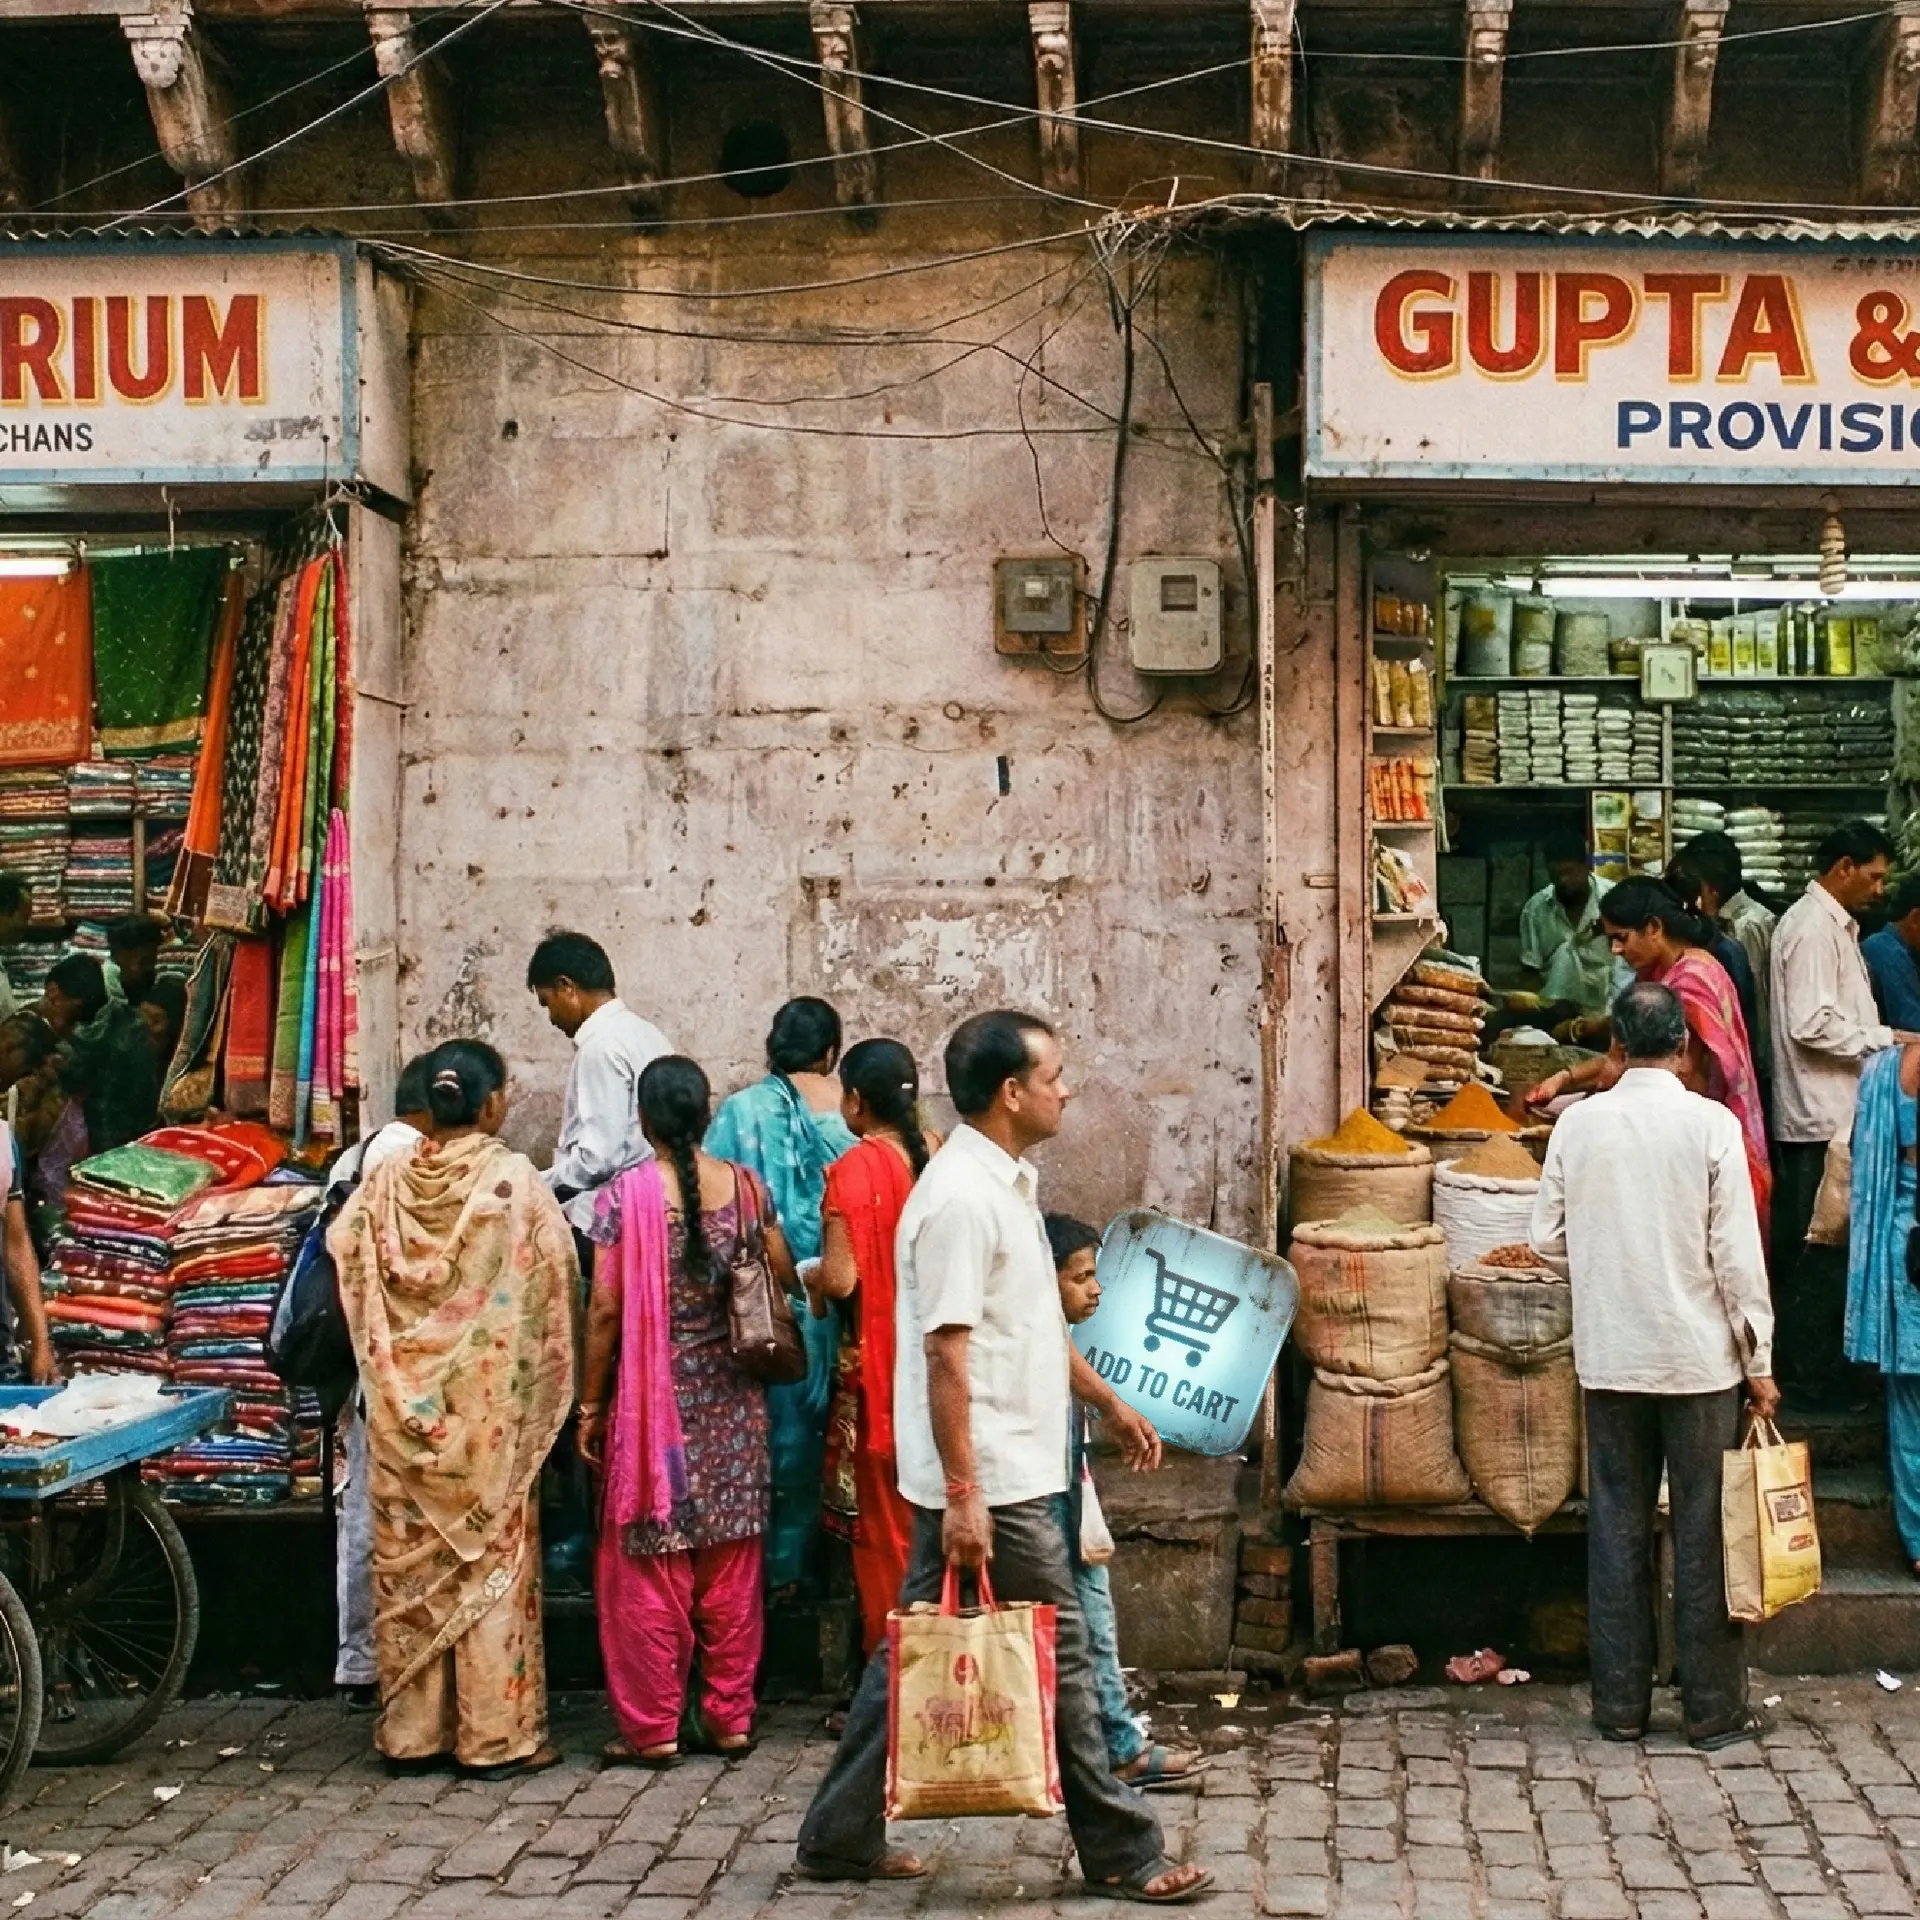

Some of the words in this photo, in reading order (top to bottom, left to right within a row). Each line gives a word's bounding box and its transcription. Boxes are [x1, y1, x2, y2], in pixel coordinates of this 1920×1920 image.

[0, 295, 266, 406] RIUM
[1374, 269, 1817, 385] GUPTA
[1848, 290, 1920, 388] &
[1617, 402, 1920, 451] PROVISI
[1084, 1346, 1132, 1385] ADD
[1137, 1364, 1168, 1399] TO
[1172, 1379, 1240, 1423] CART
